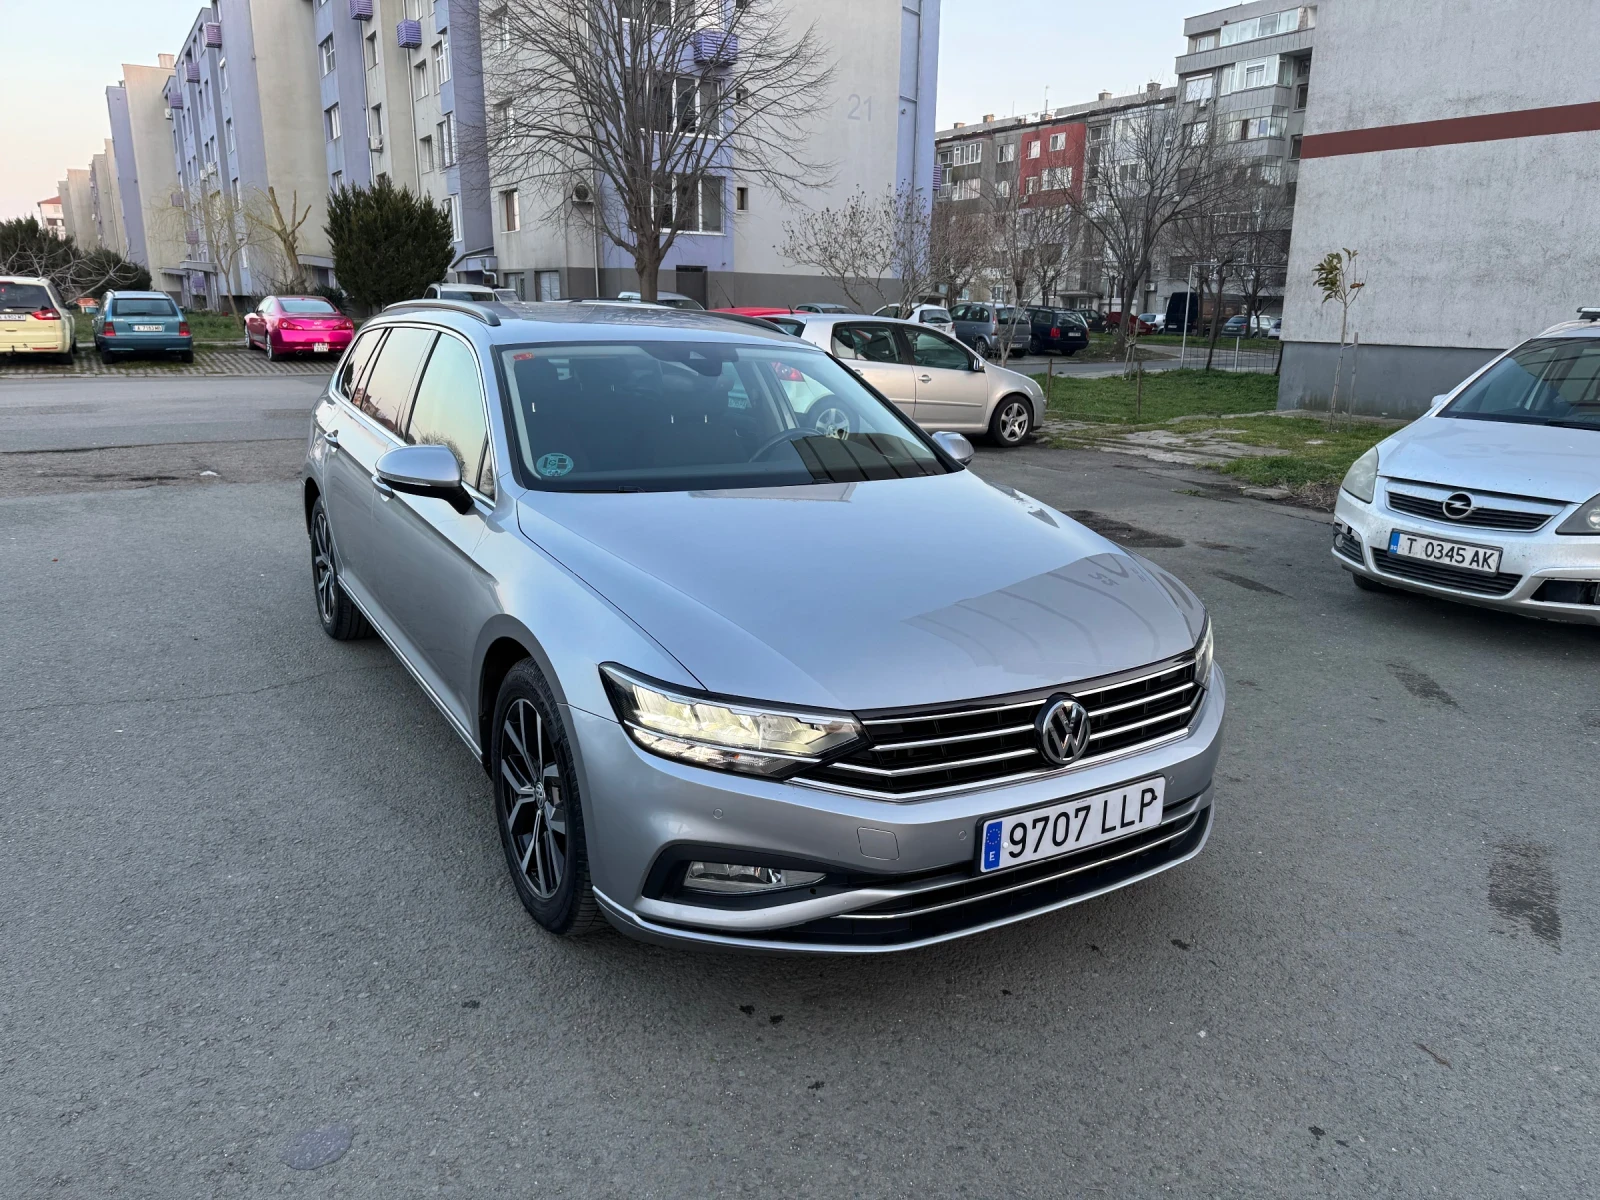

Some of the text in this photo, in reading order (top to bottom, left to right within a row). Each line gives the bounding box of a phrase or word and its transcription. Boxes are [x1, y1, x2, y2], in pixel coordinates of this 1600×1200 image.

[847, 94, 872, 121] 21
[1407, 537, 1417, 554] T
[1425, 541, 1466, 564] 0345
[1469, 550, 1495, 570] AK
[989, 787, 1157, 861] E 9707 LLP
